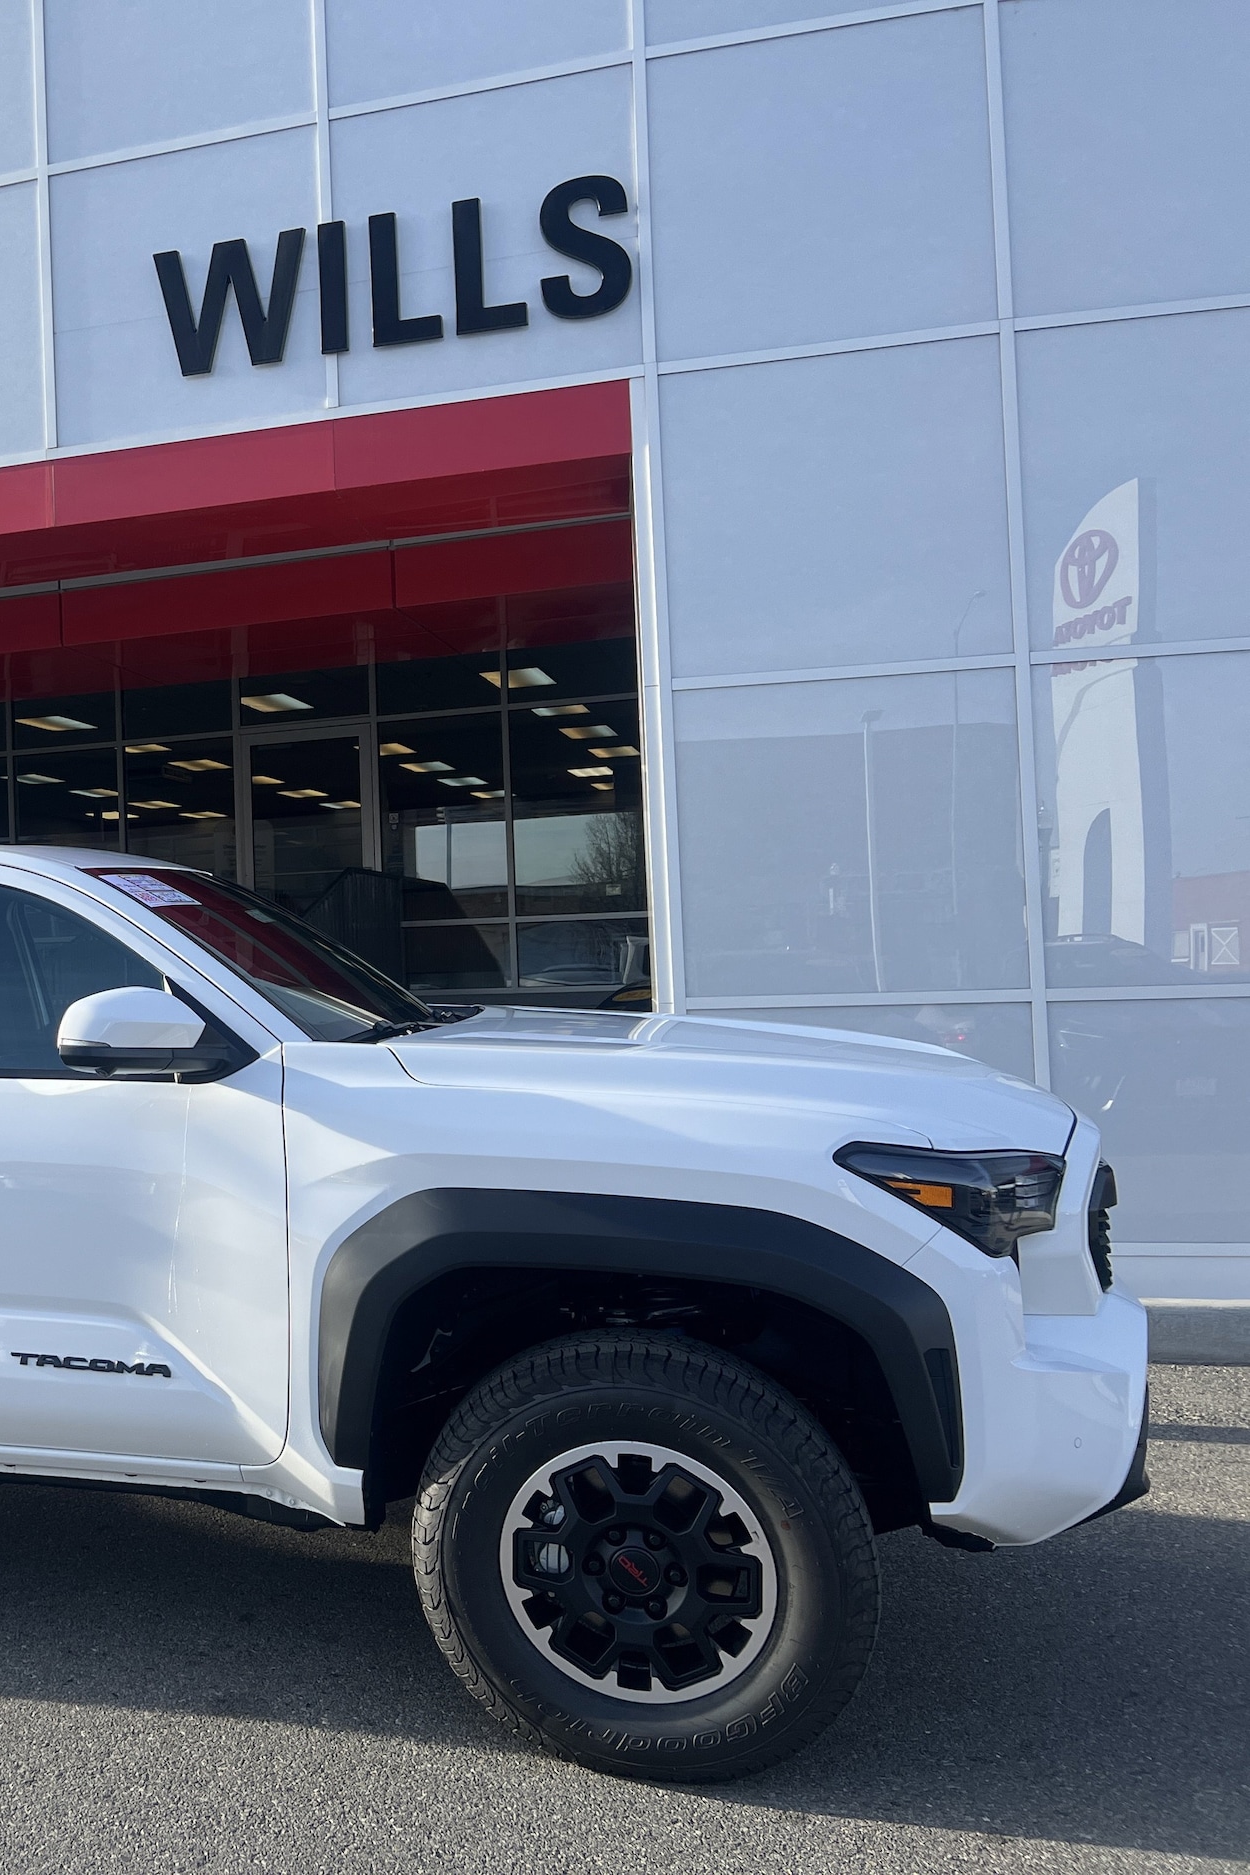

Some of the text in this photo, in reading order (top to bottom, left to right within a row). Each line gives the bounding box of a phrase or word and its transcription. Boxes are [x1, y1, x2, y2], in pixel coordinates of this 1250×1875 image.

[153, 174, 632, 377] WILLS
[11, 1352, 171, 1377] TACOMA
[618, 1555, 648, 1587] TRD
[510, 1662, 810, 1752] BFGoodrich
